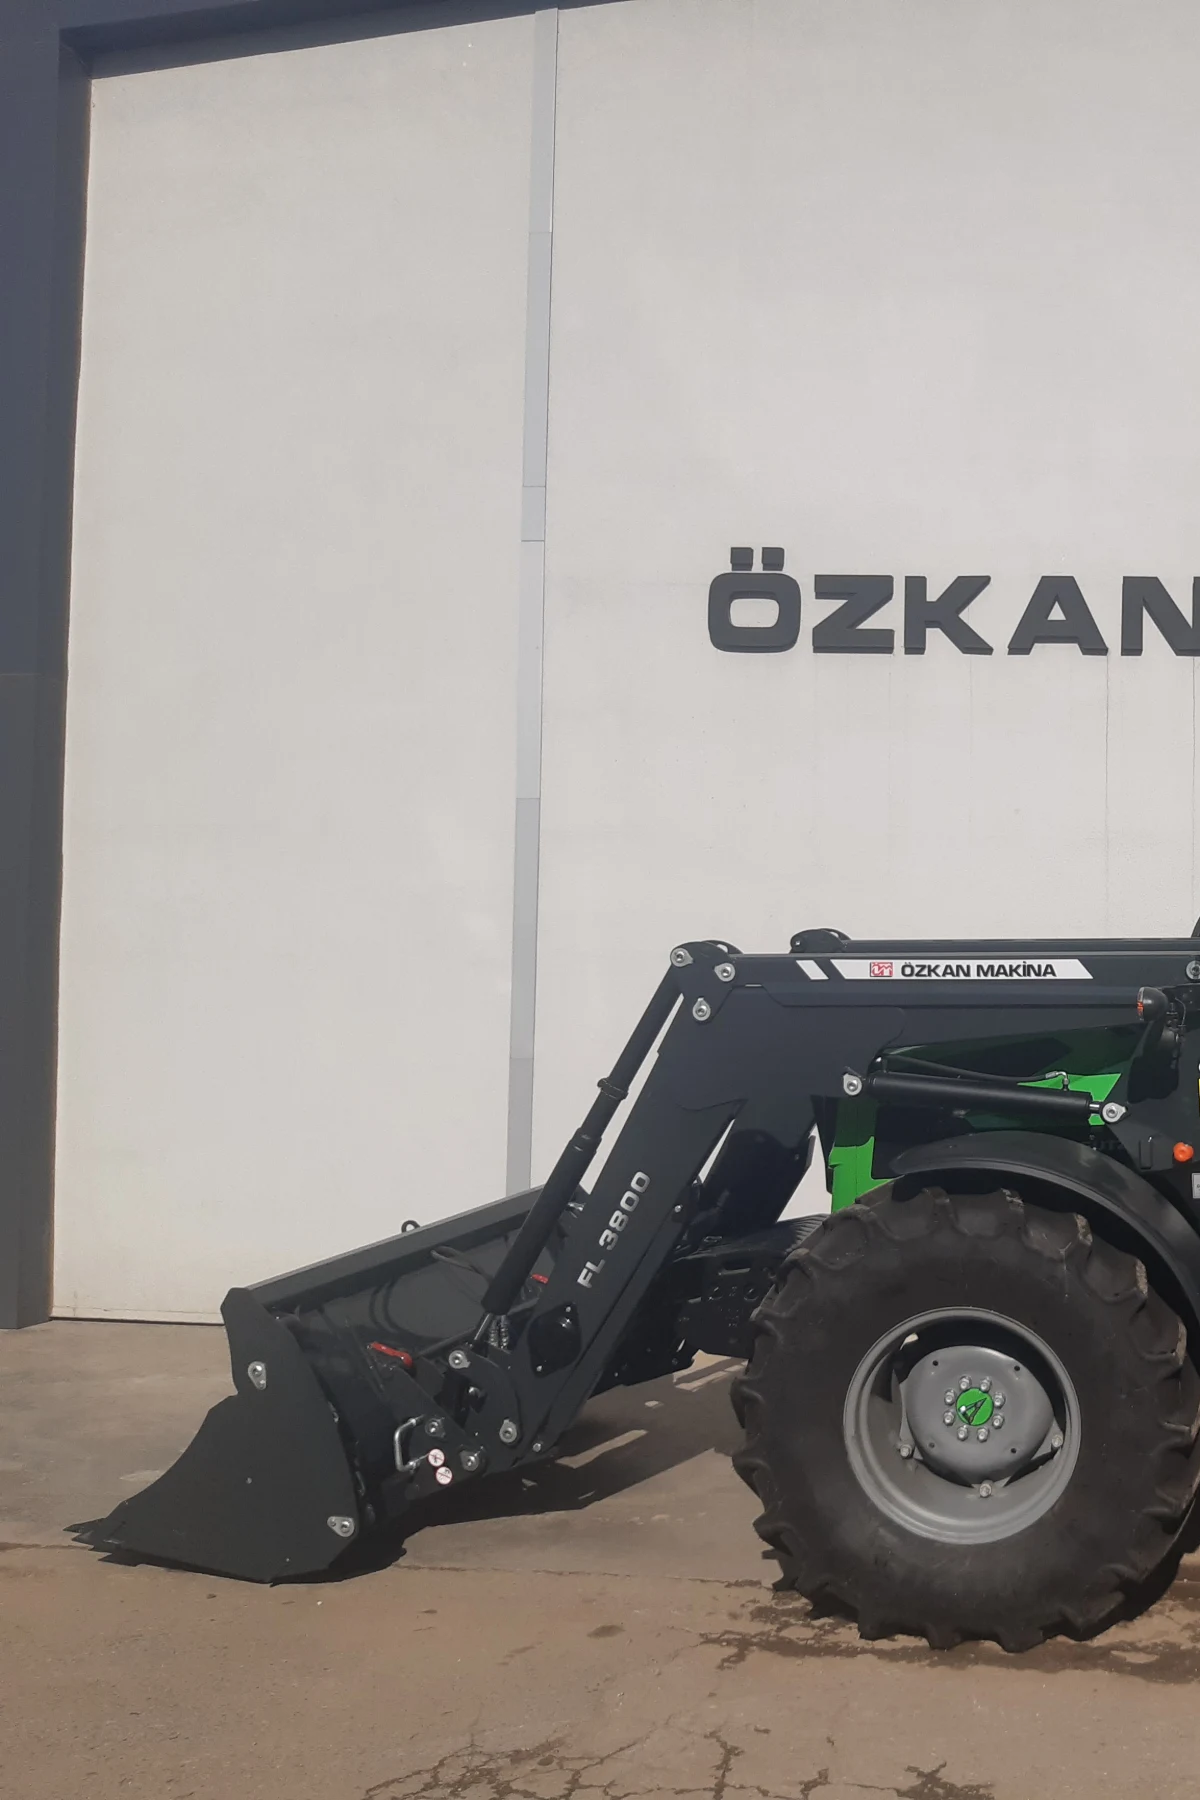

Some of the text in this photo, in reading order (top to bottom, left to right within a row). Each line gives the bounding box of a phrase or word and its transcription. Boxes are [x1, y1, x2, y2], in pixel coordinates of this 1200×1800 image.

[901, 961, 971, 977] ÖZKAN
[976, 961, 1057, 977] MAKİNA
[577, 1171, 651, 1289] FL 3800
